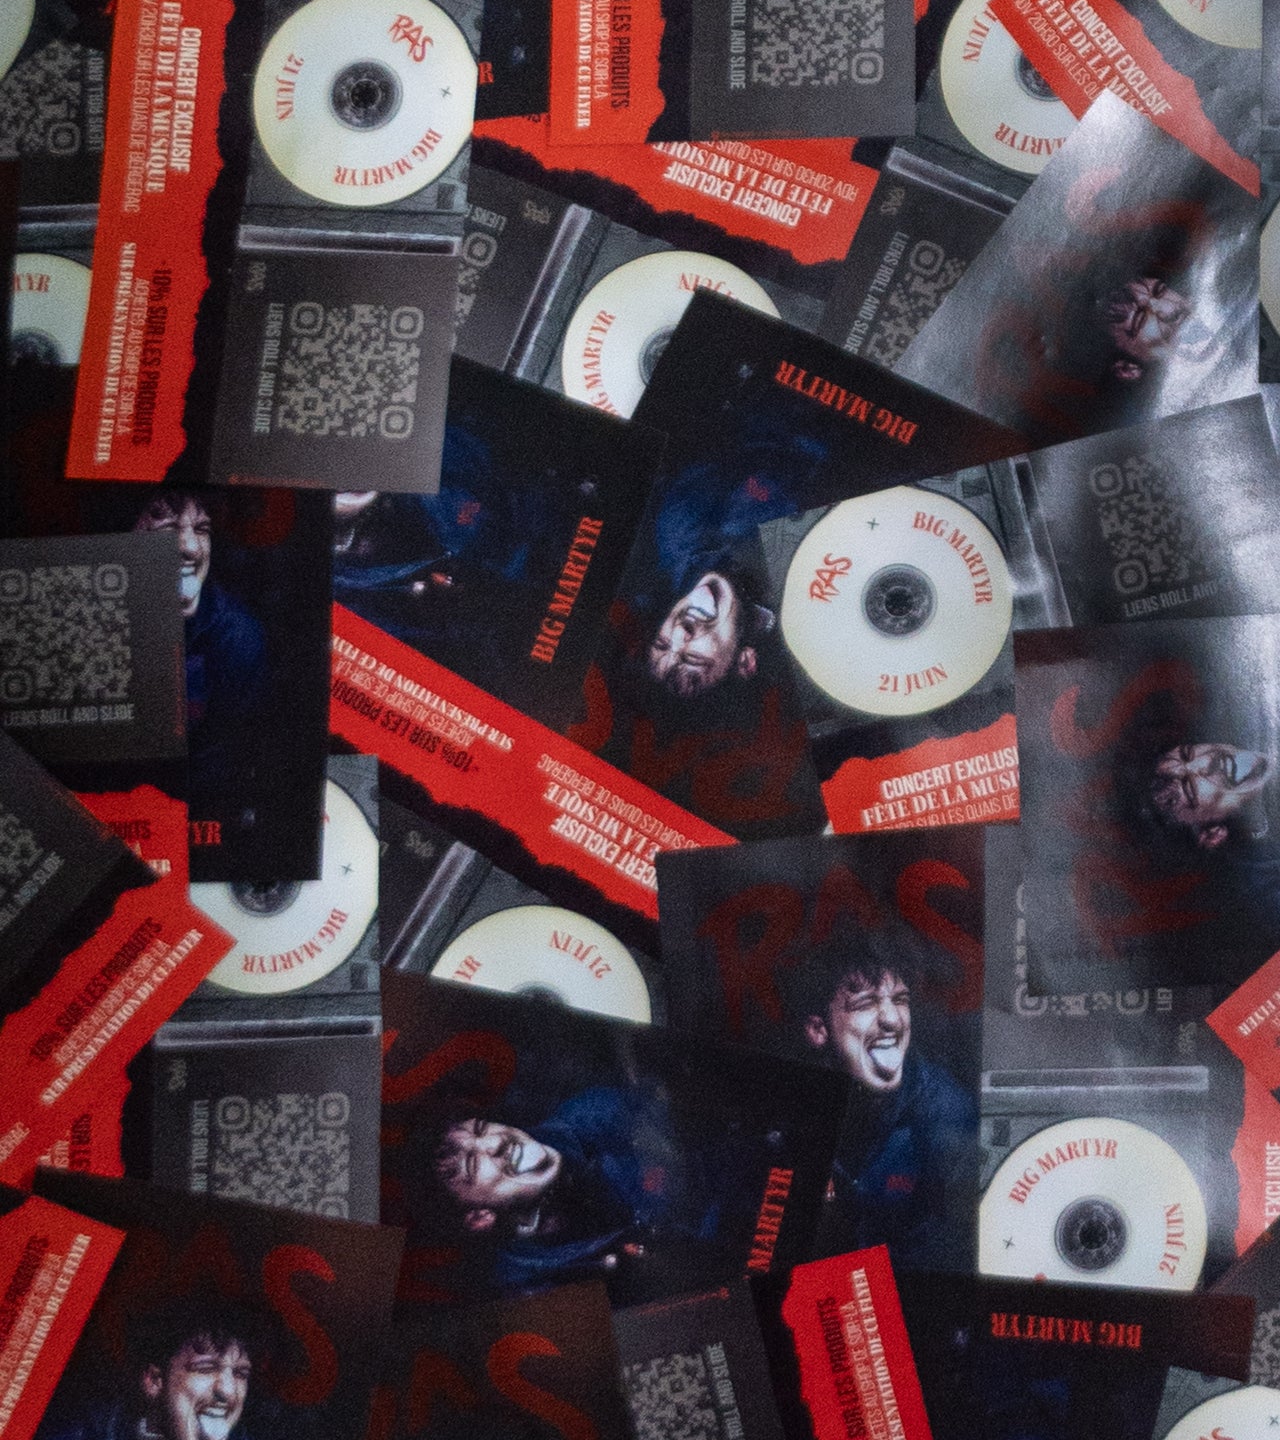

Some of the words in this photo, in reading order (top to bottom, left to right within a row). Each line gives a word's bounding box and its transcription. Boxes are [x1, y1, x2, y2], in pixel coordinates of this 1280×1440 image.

[729, 28, 746, 53] AND
[729, 55, 747, 89] SLIDE
[770, 358, 876, 423] MARTYR
[870, 407, 917, 445] BIG
[546, 513, 606, 617] MARTYR
[806, 552, 853, 604] RAS
[911, 511, 945, 538] BIG
[946, 528, 994, 606] MARTYR
[529, 615, 567, 664] BIG
[876, 674, 900, 695] 21
[903, 665, 949, 697] JUIN
